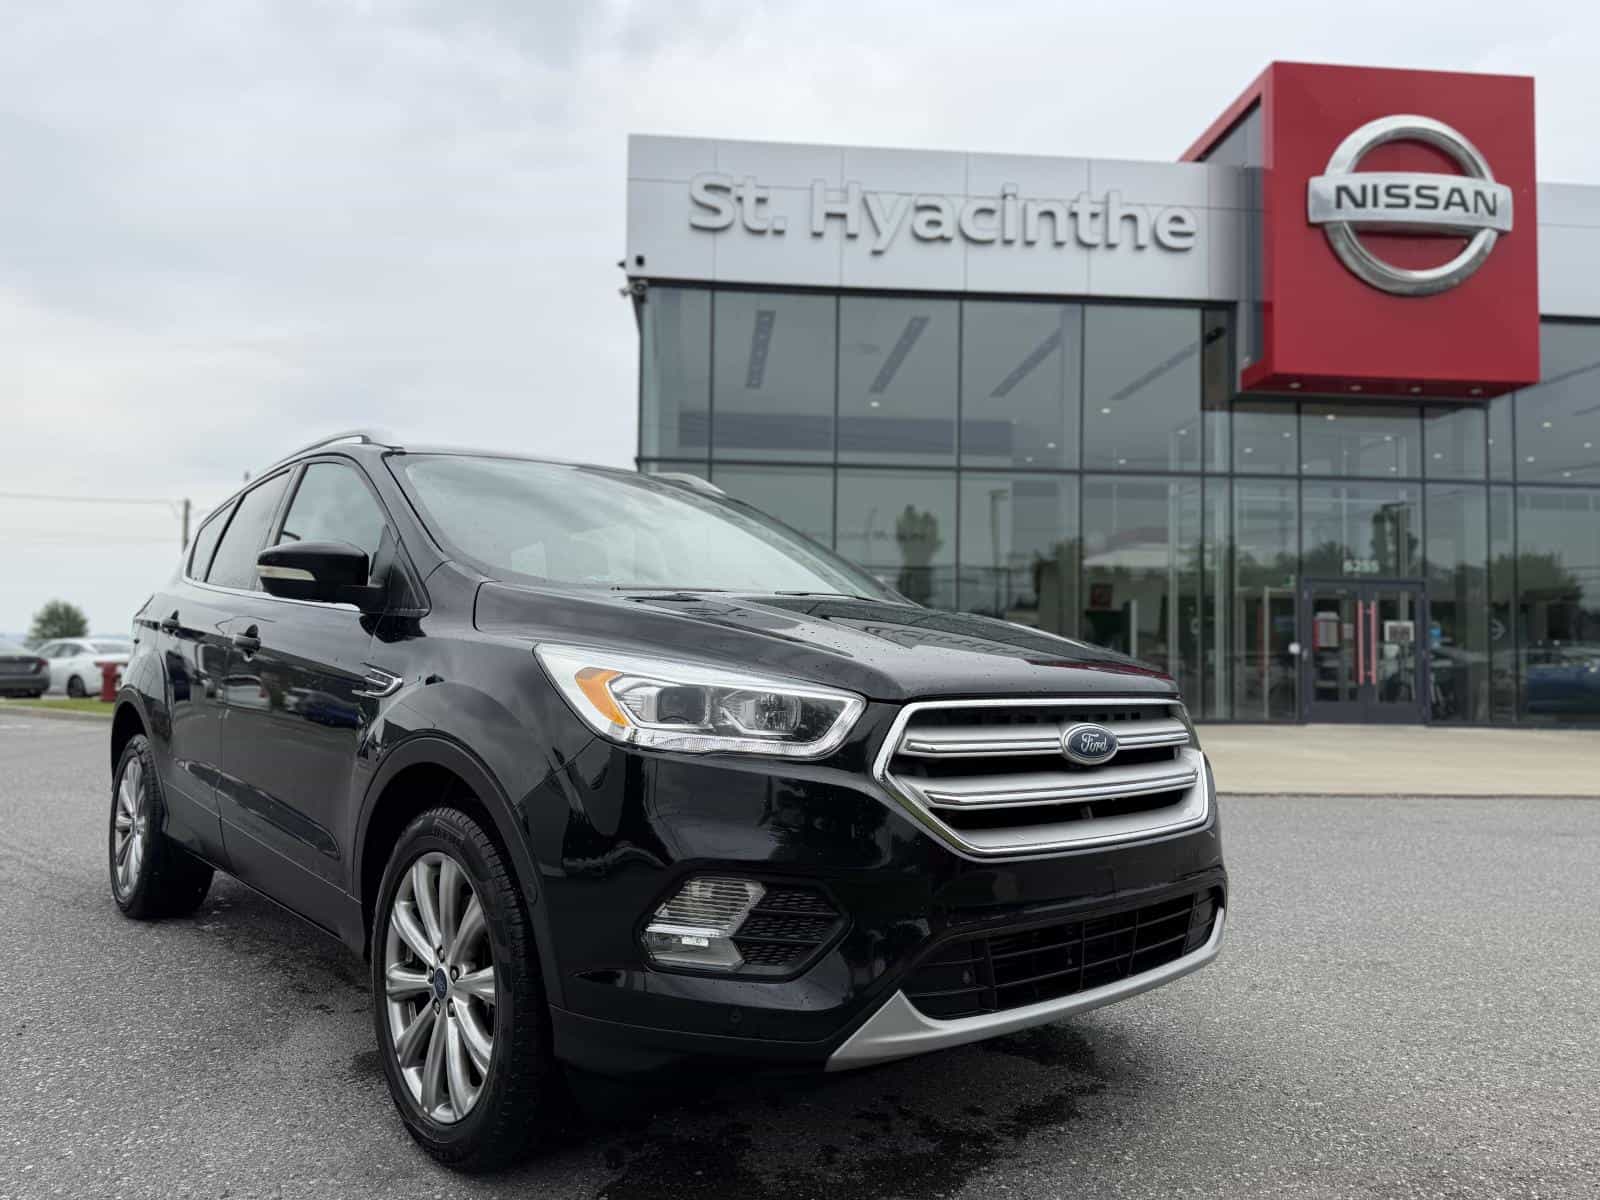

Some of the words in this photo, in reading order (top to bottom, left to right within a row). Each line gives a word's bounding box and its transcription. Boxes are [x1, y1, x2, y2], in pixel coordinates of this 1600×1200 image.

[690, 173, 786, 234] St.
[811, 178, 1197, 256] Hyacinthe
[1335, 184, 1497, 217] NISSAN
[1081, 733, 1108, 752] Ford
